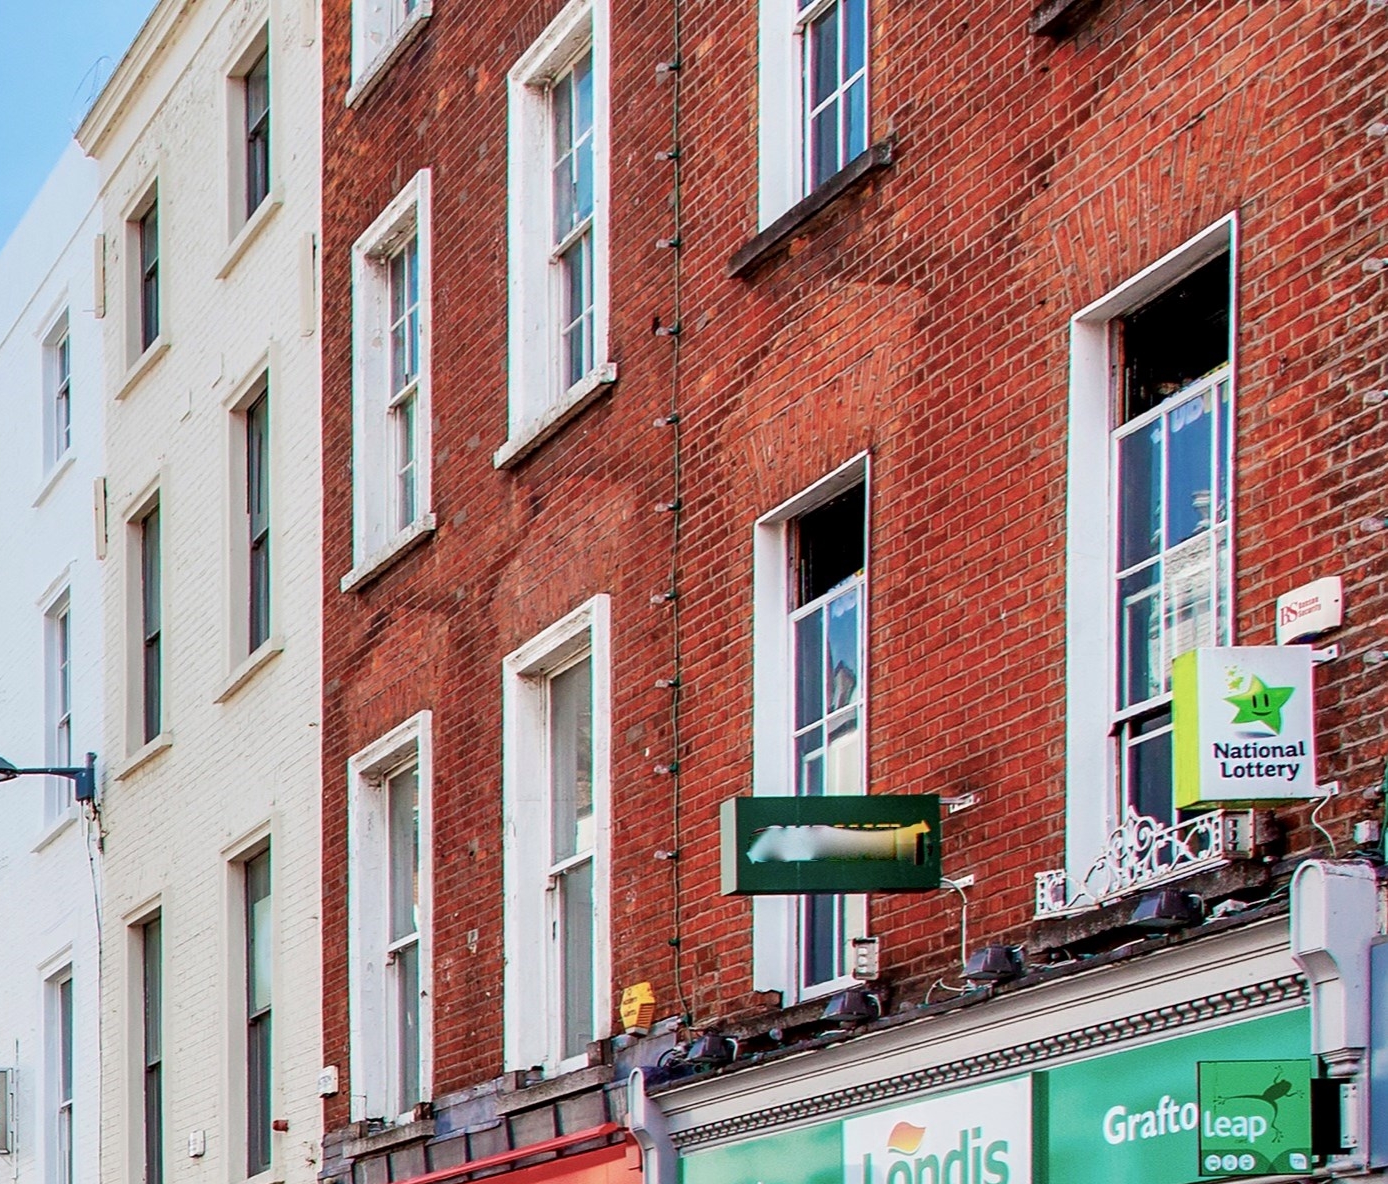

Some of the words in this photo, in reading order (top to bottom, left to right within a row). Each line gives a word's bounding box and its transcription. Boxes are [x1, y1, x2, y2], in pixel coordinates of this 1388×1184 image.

[1212, 741, 1306, 759] National
[1220, 761, 1300, 782] Lottery
[1102, 1094, 1200, 1145] Grafto
